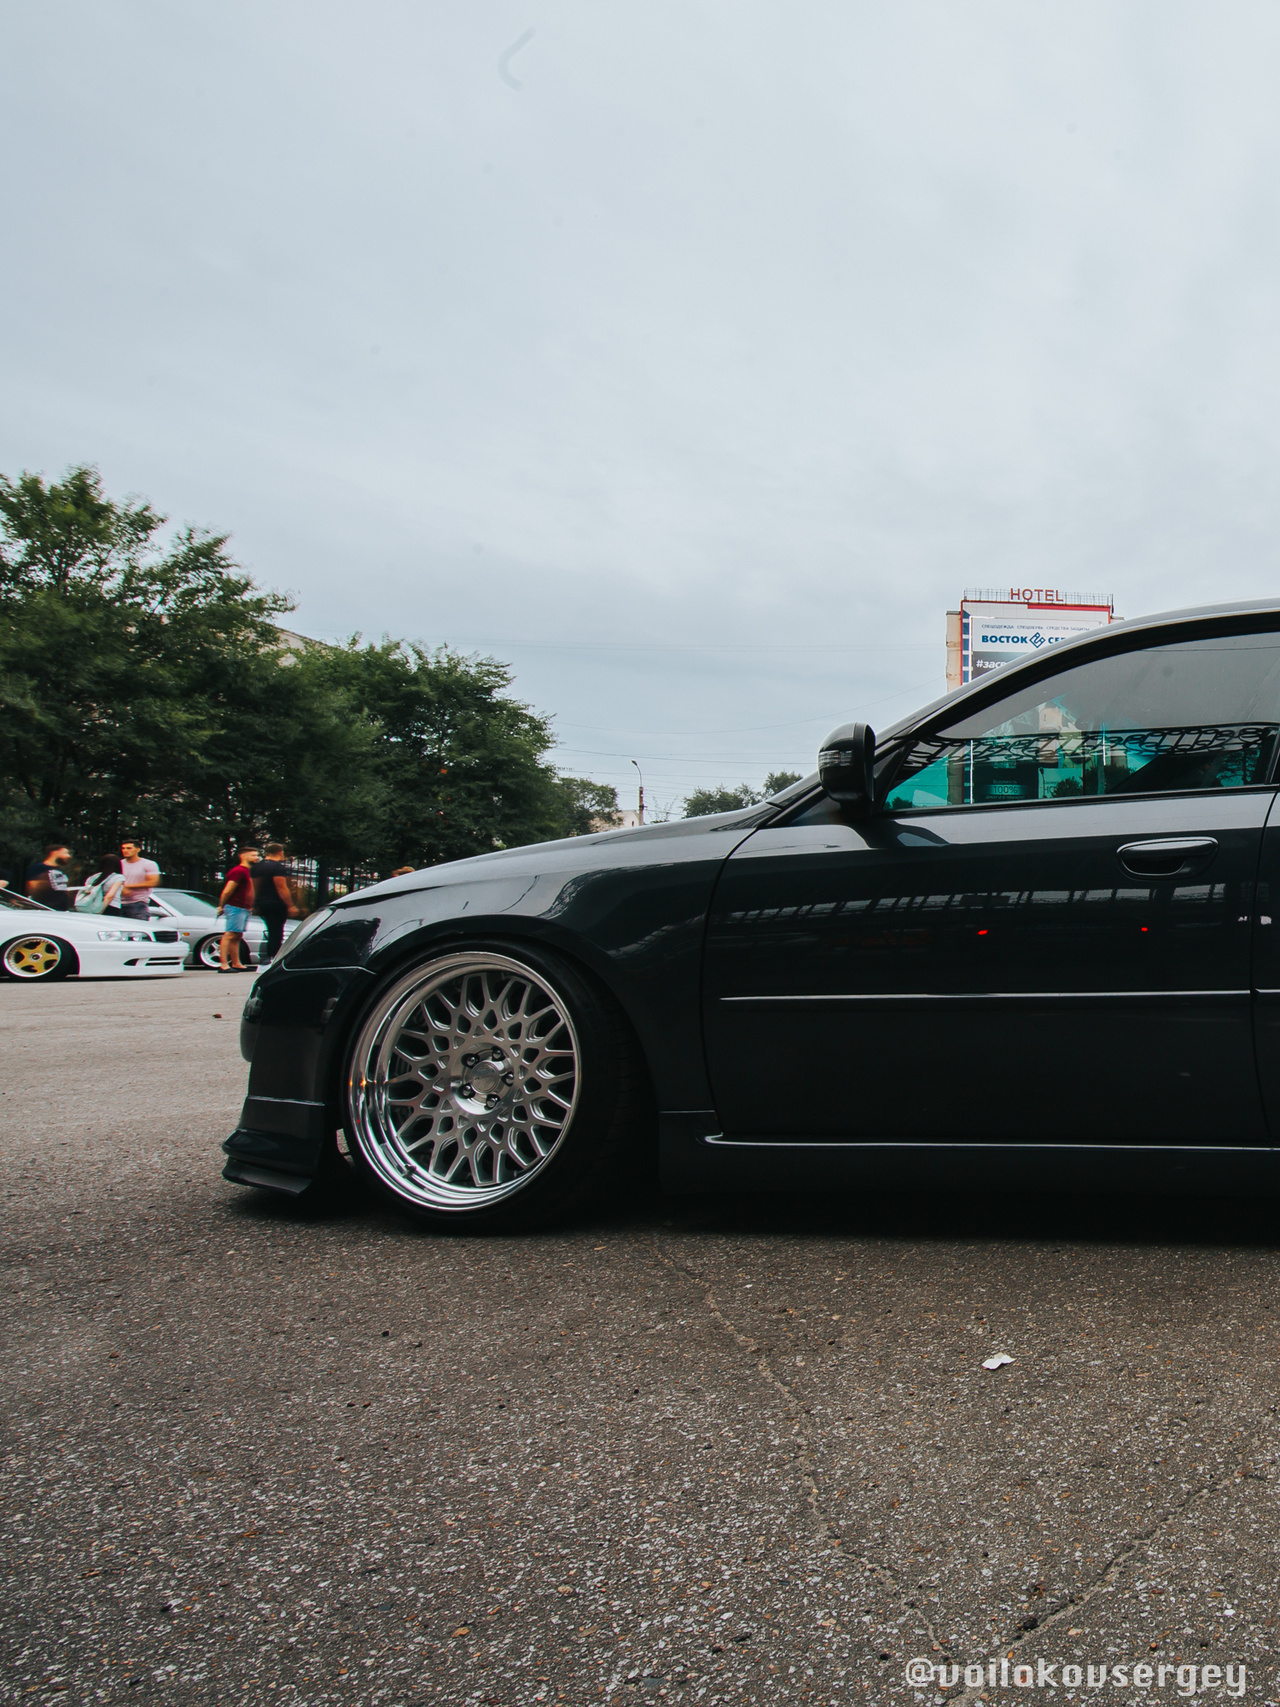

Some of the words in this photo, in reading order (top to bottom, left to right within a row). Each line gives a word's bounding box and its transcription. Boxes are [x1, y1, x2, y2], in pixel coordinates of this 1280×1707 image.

[1010, 588, 1064, 602] HOTEL
[981, 635, 1028, 644] ВОСТОК
[993, 785, 1018, 794] 100%
